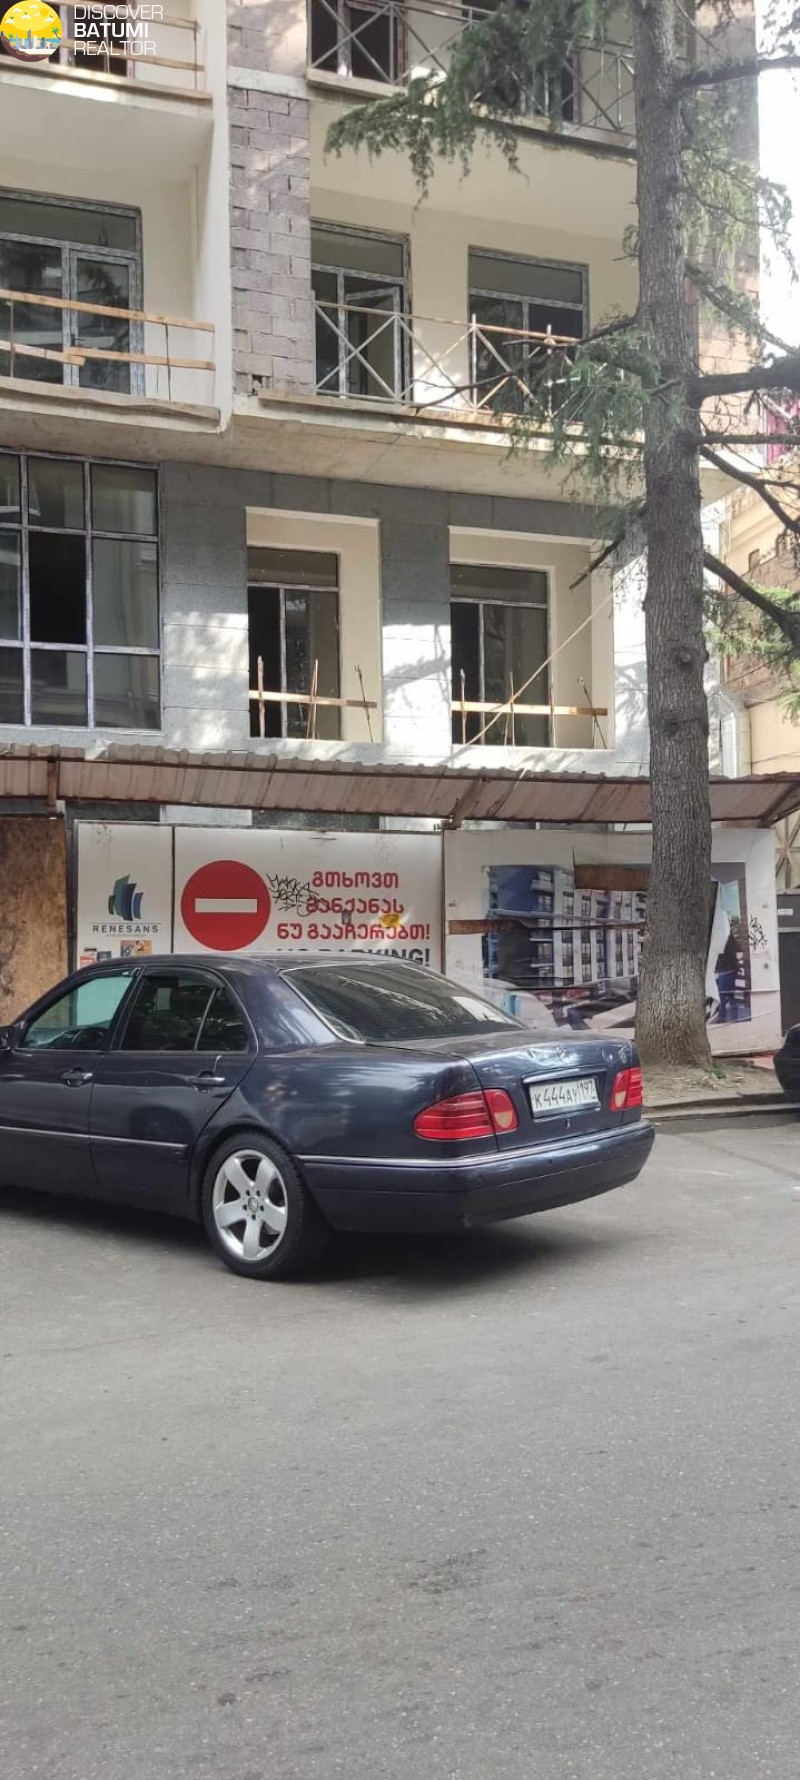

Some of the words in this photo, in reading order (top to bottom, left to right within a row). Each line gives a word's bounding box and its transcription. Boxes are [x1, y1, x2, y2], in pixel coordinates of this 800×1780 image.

[311, 871, 399, 888] გთხოვთ
[305, 897, 405, 914] მანქანას
[92, 925, 159, 933] RENESANS
[276, 923, 302, 940] ნუ
